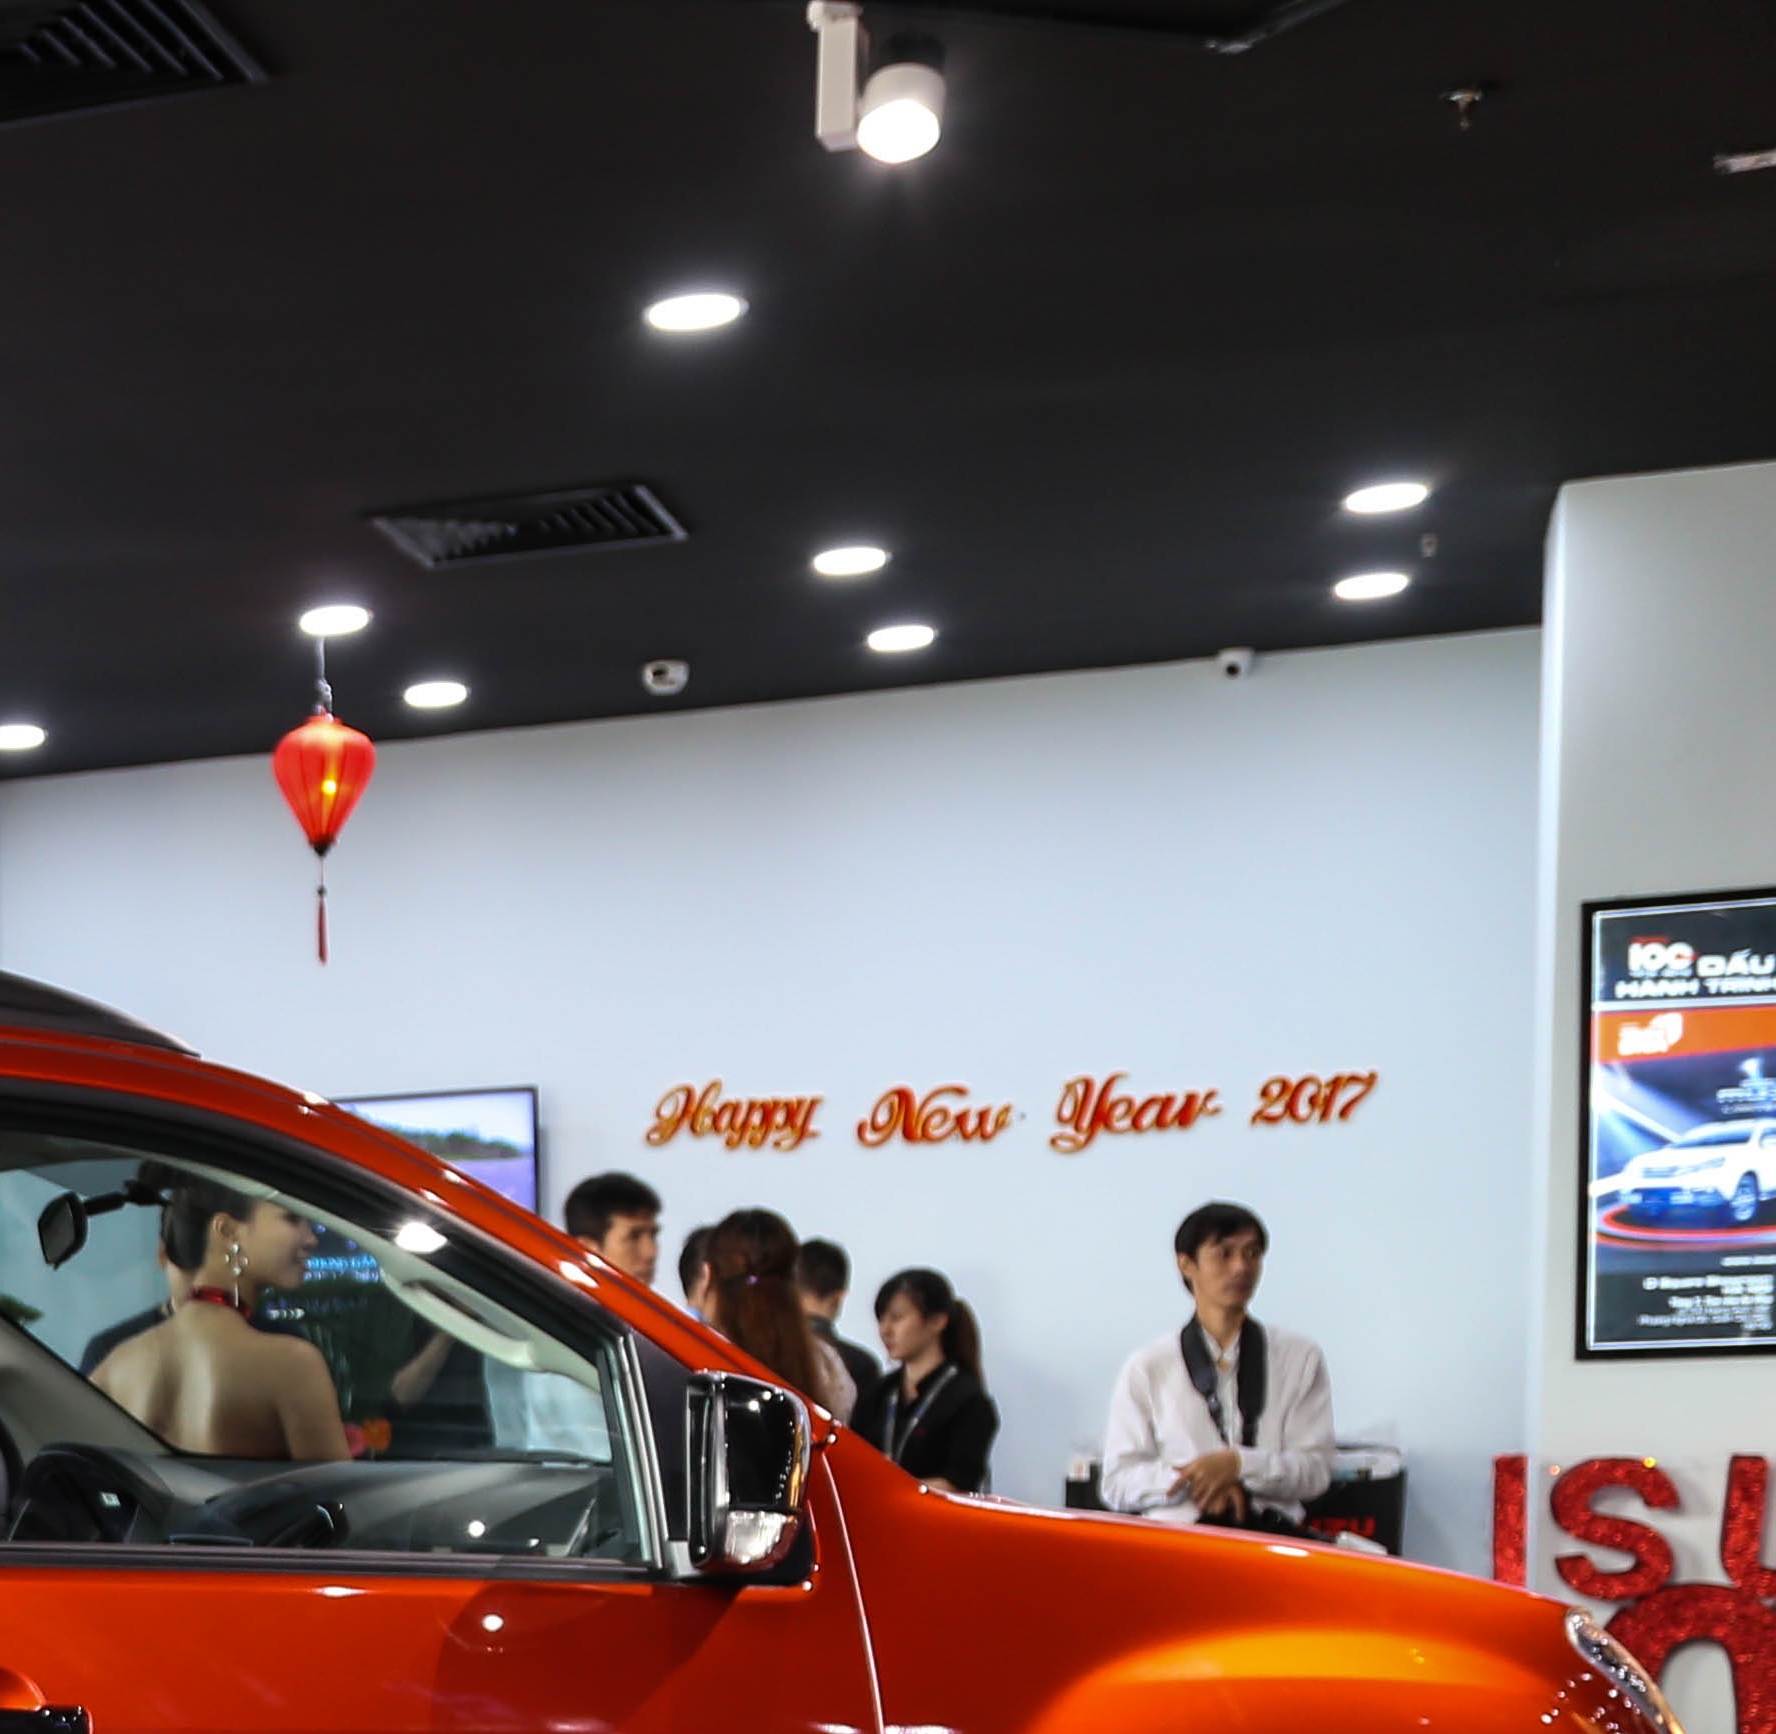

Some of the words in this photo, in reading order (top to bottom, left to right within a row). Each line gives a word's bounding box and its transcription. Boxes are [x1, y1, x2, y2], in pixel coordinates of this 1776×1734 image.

[646, 1080, 822, 1151] Happy
[856, 1085, 1012, 1148] New
[1049, 1073, 1220, 1153] Year
[1250, 1072, 1378, 1125] 2017
